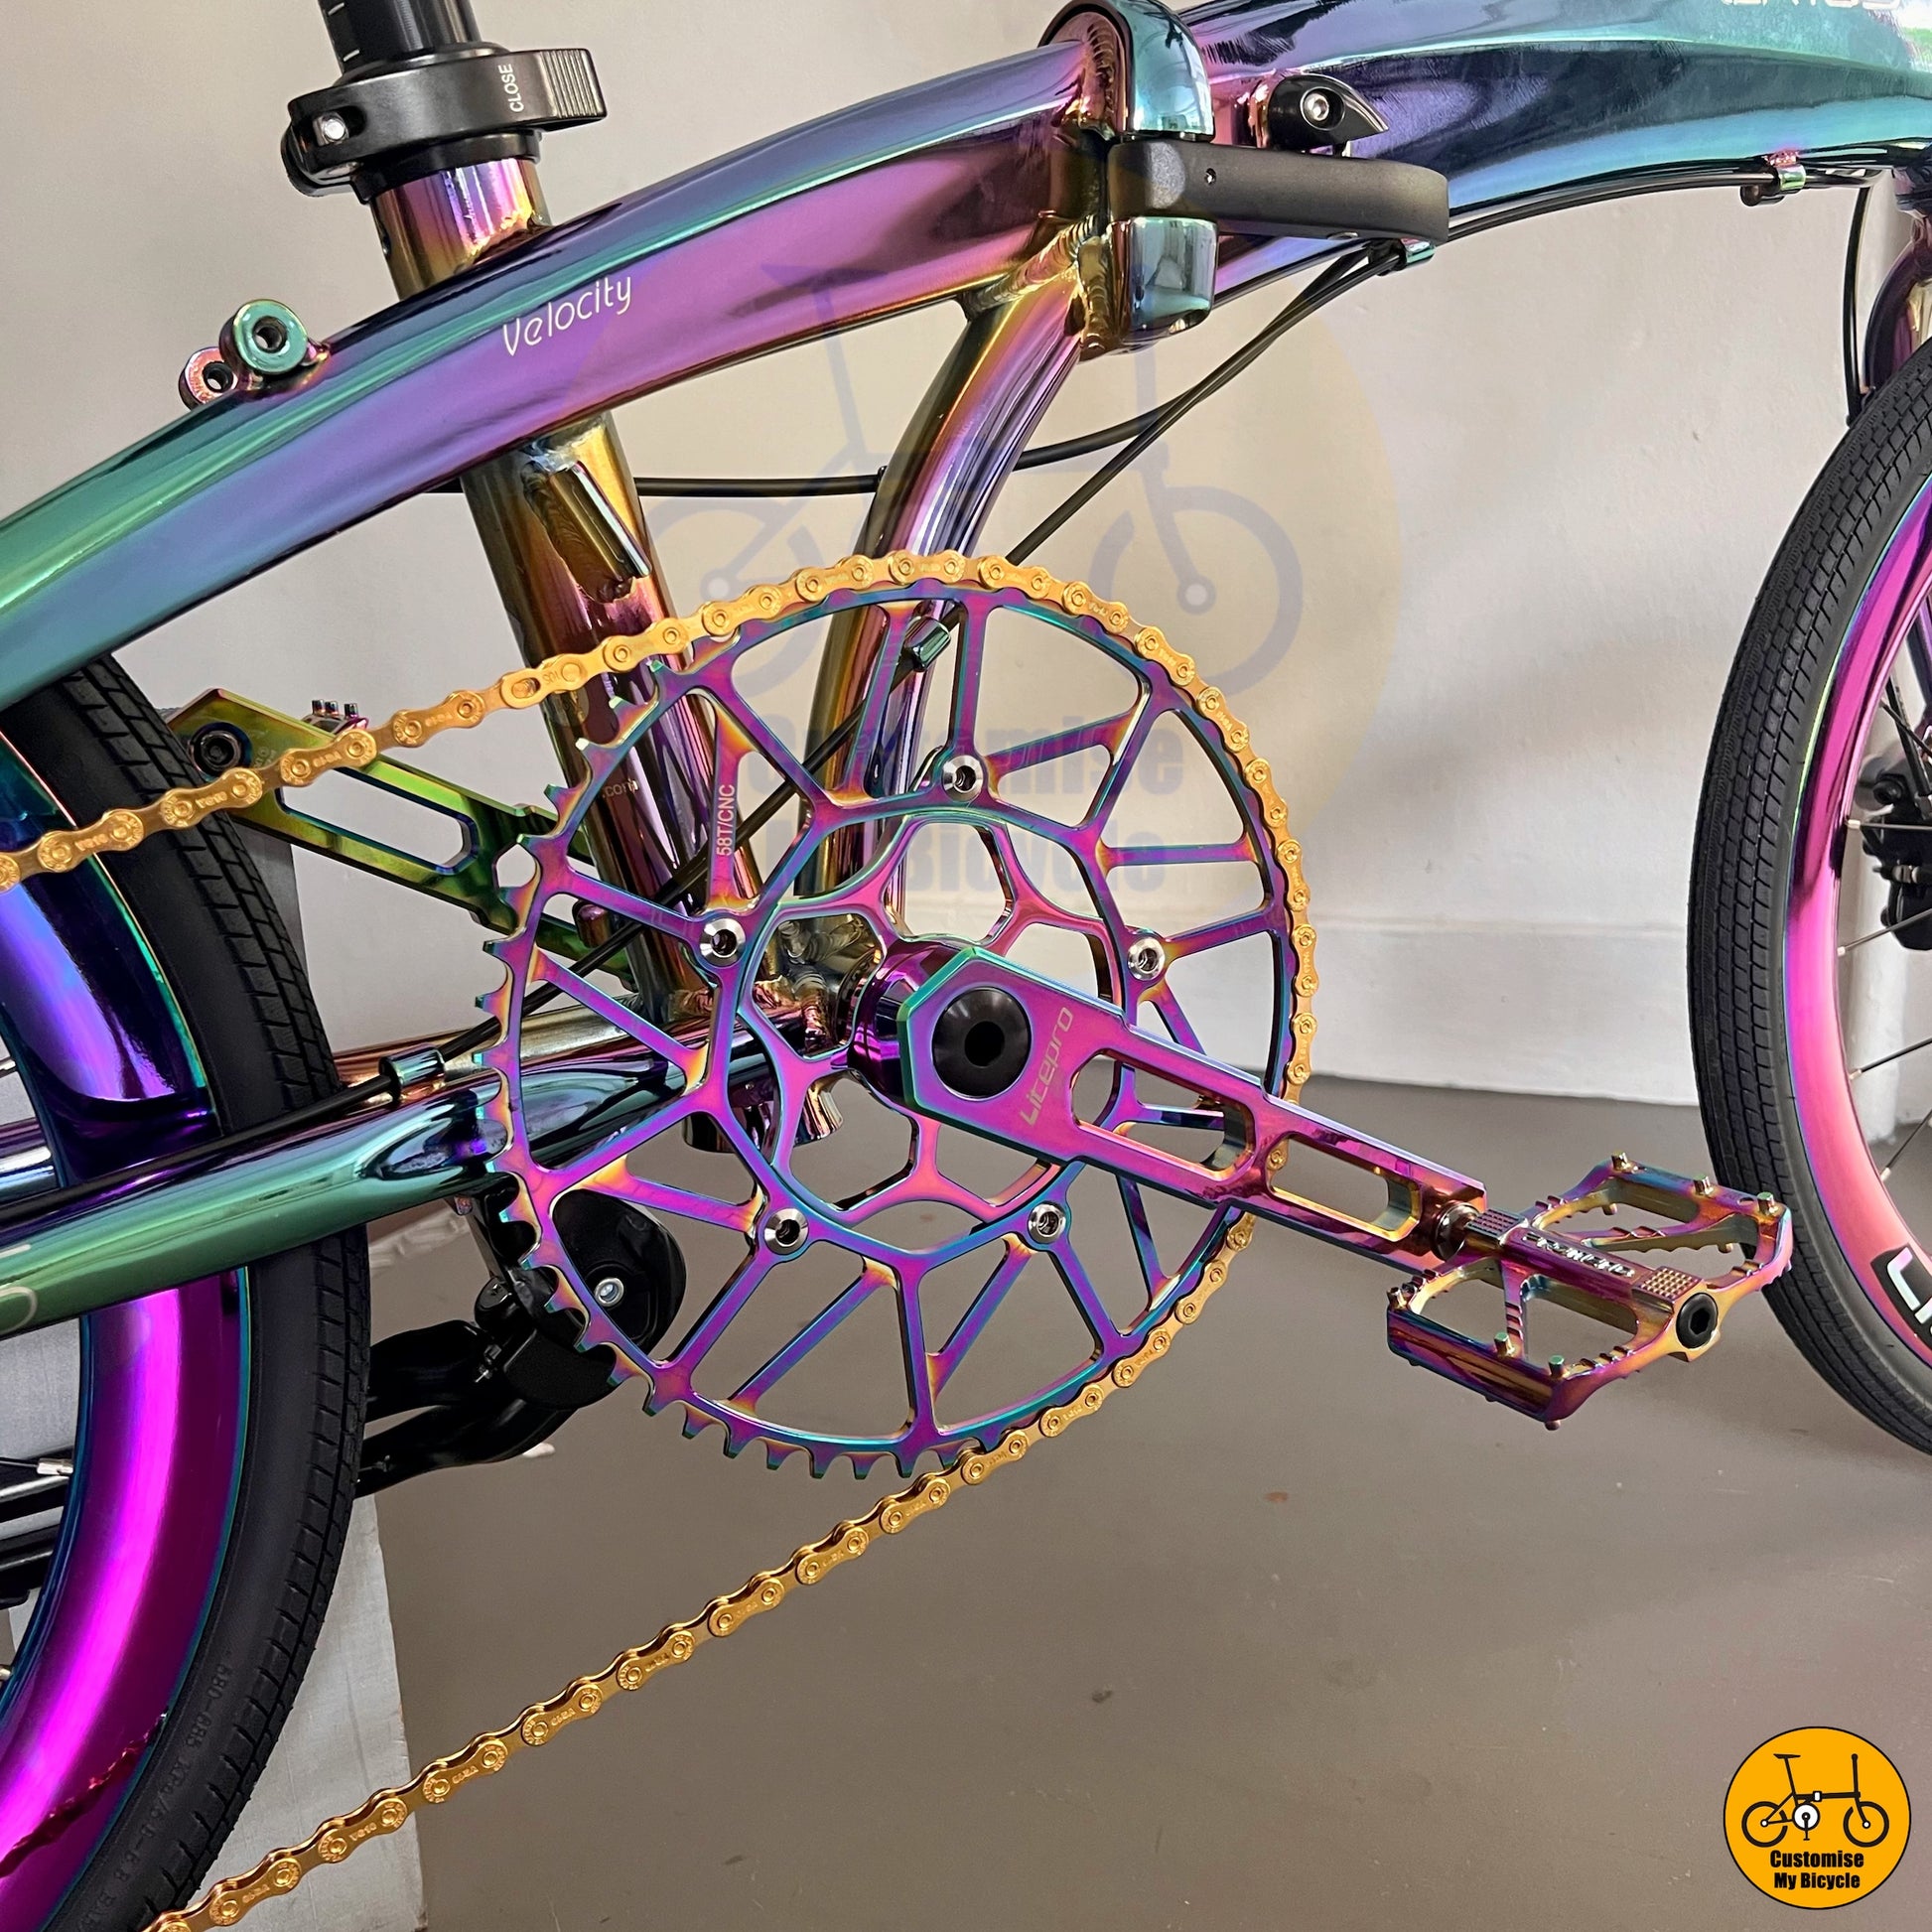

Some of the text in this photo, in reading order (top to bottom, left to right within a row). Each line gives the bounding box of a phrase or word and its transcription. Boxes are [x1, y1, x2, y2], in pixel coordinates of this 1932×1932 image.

[498, 64, 524, 112] CLOSE
[503, 276, 631, 356] Velocity
[716, 784, 735, 856] 58T/CNC
